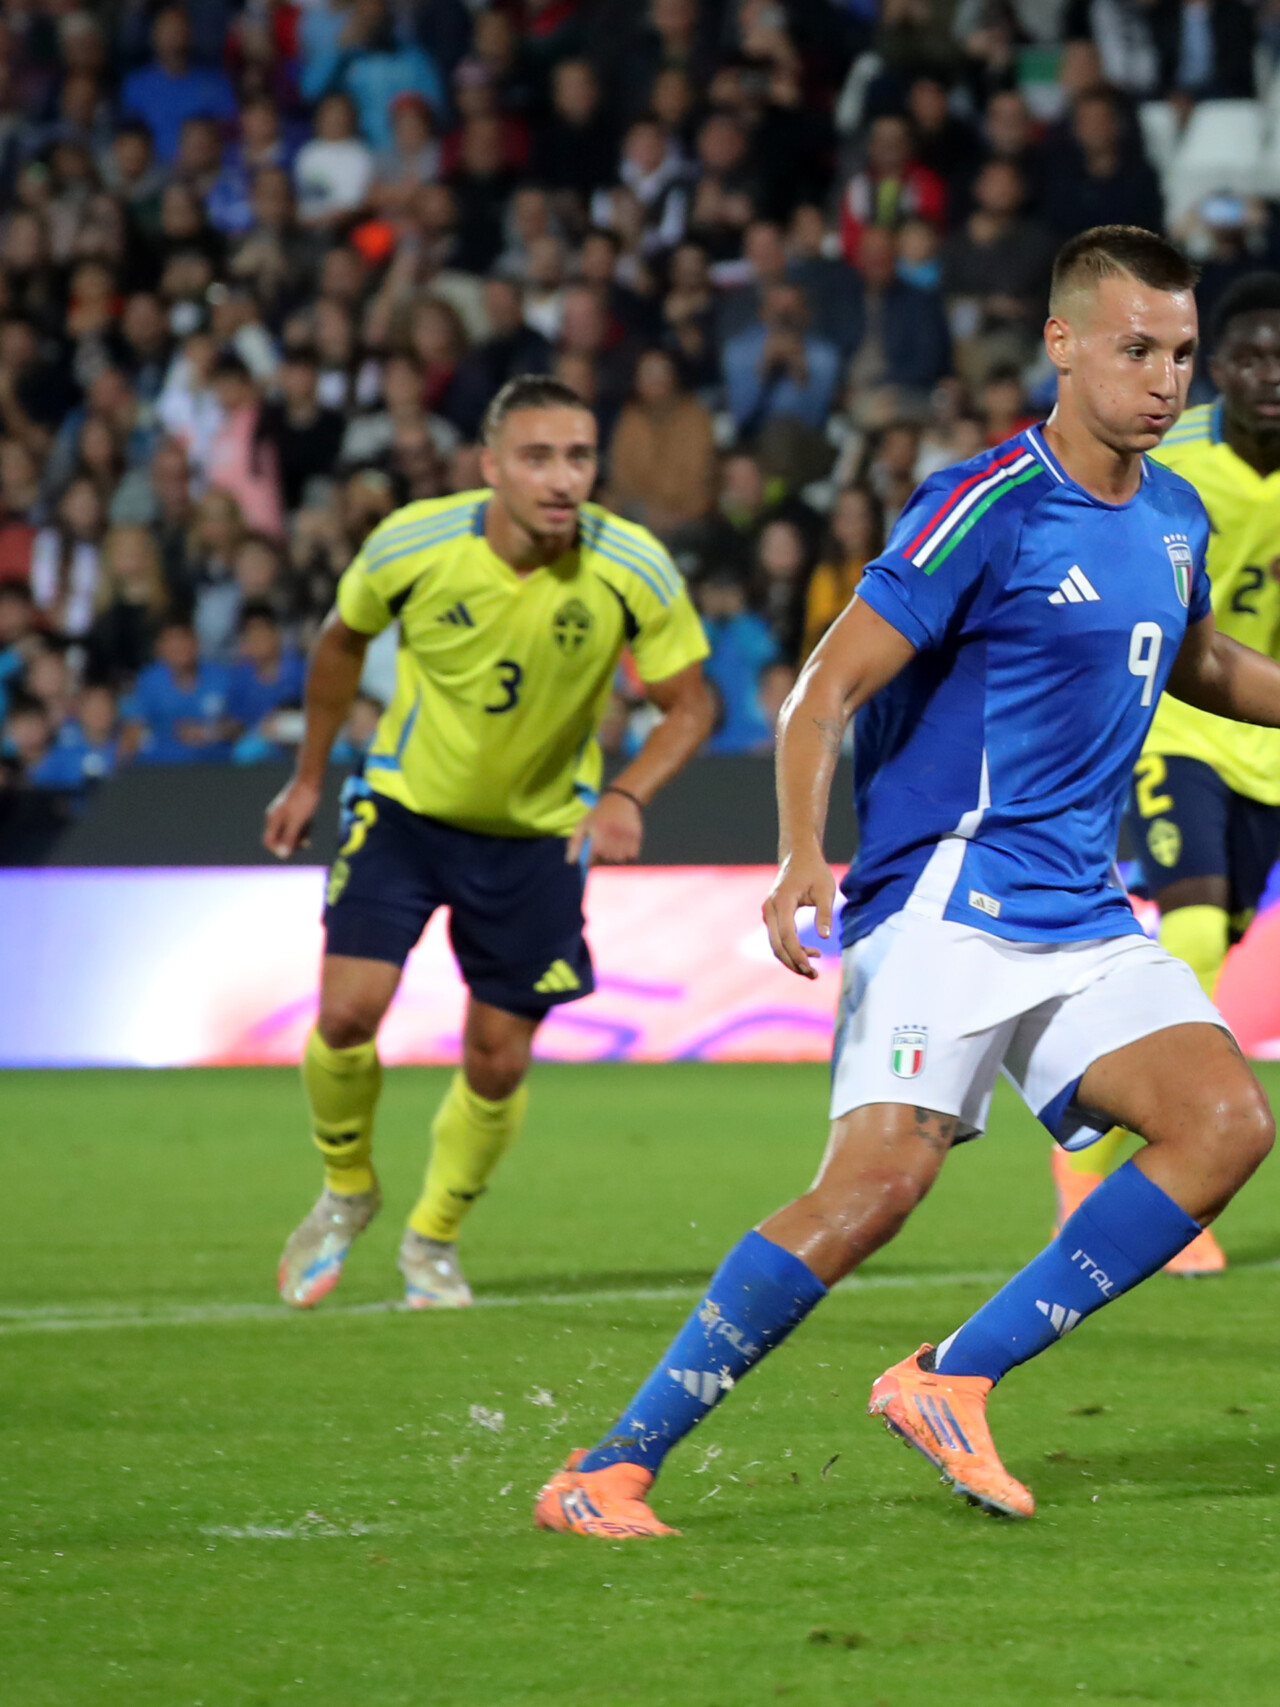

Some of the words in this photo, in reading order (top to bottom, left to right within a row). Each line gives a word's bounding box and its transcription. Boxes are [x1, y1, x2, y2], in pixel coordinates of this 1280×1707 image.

[1231, 567, 1264, 613] 2
[485, 660, 523, 713] 3
[1128, 621, 1163, 706] 9
[1134, 754, 1174, 818] 2
